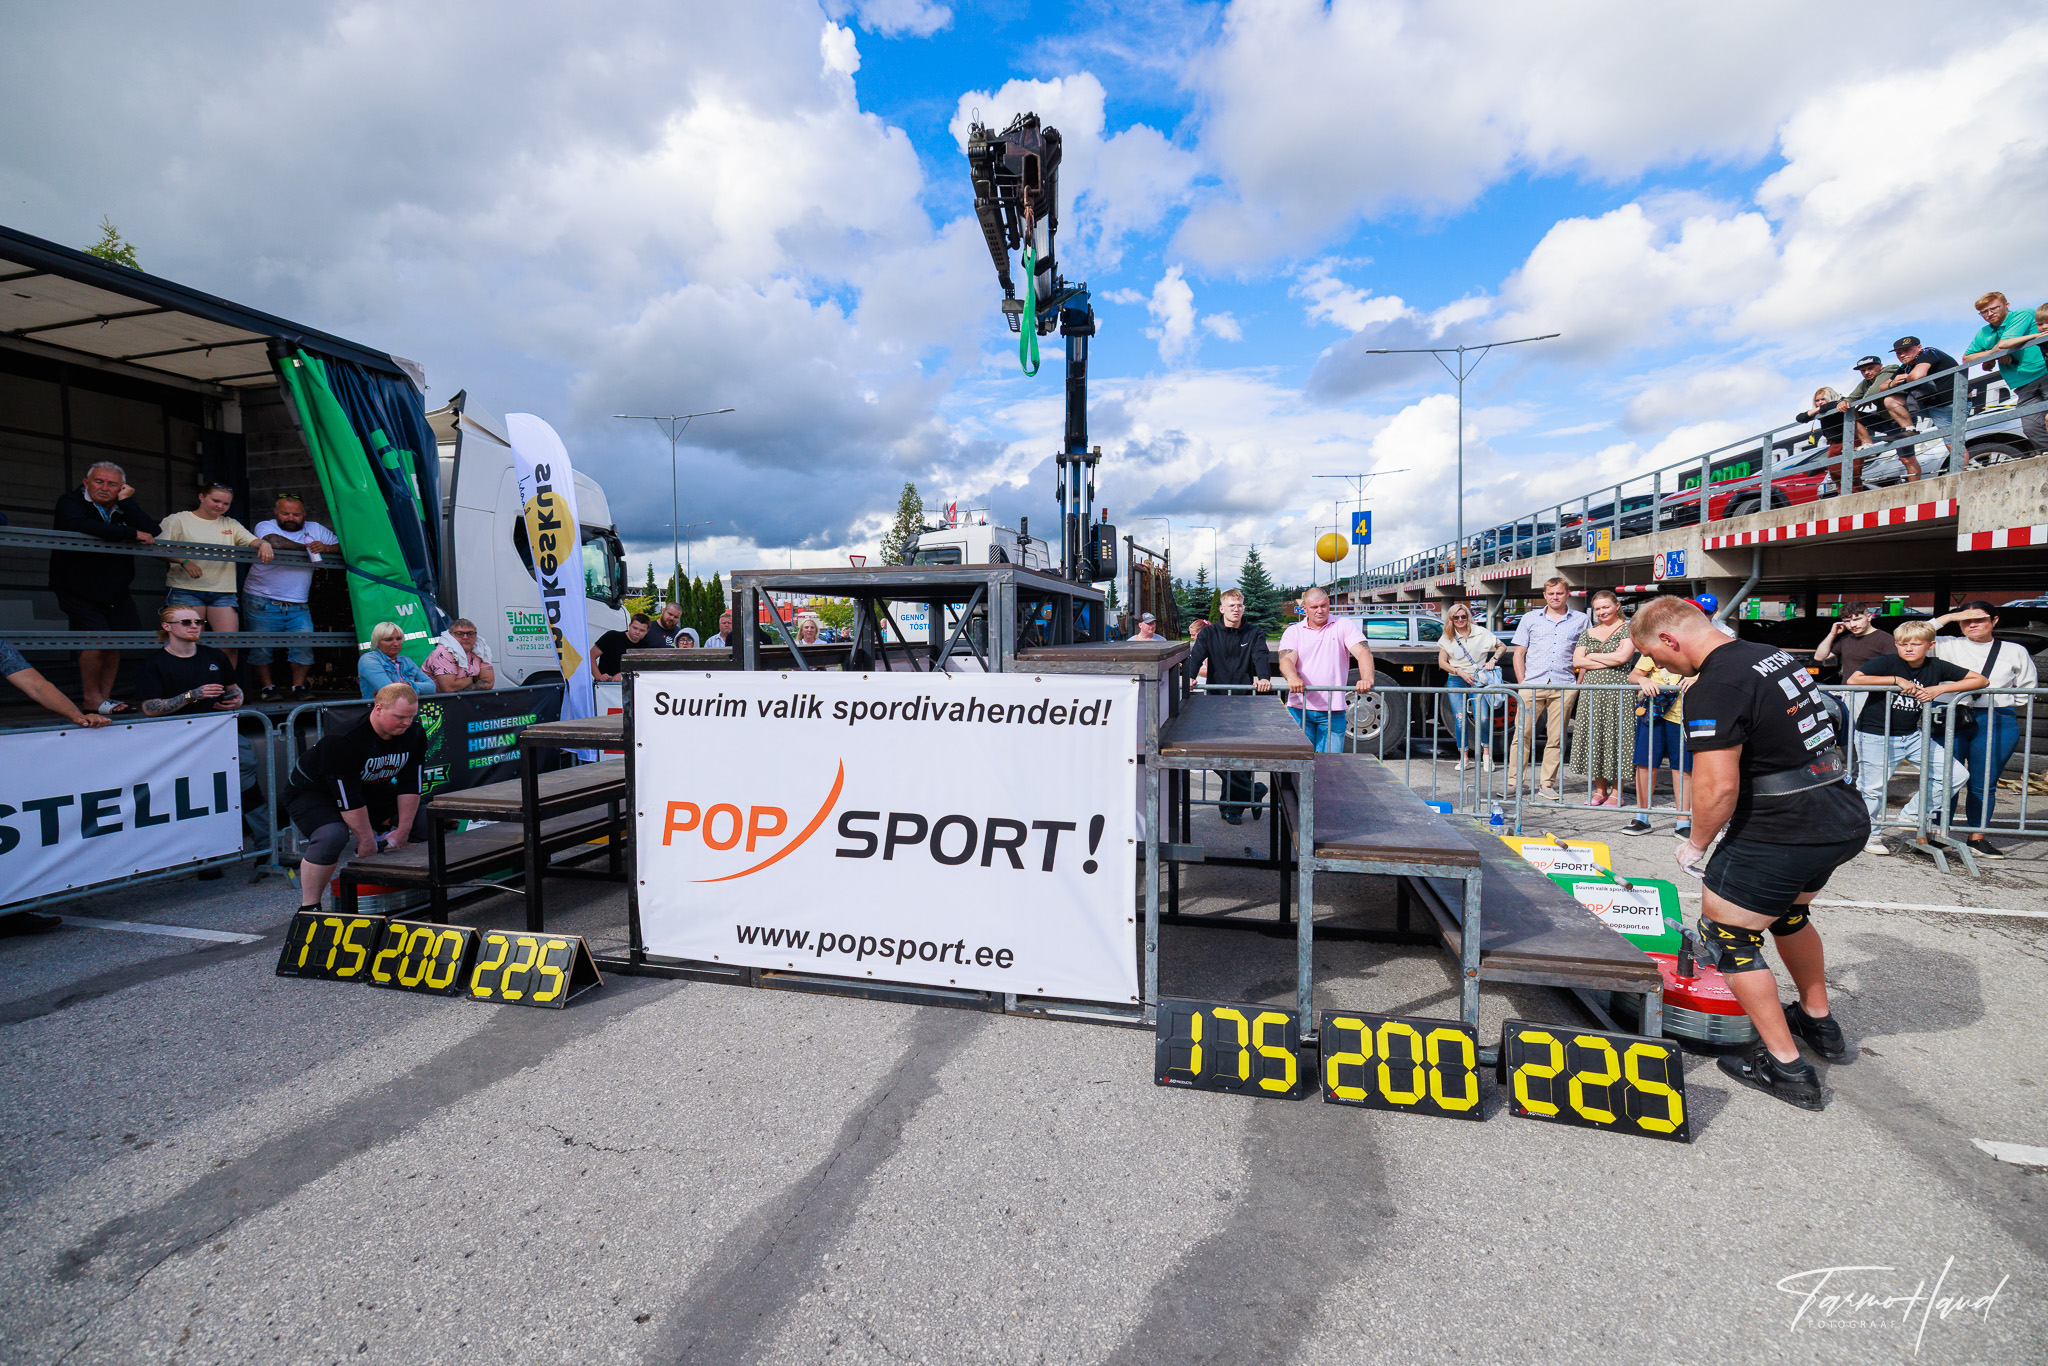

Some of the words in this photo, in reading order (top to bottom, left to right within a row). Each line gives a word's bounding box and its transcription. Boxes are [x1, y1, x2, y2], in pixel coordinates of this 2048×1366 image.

[1355, 519, 1368, 536] 4
[900, 613, 925, 621] GENNO
[468, 714, 537, 733] ENGINEERING
[654, 692, 747, 718] Suurim
[757, 695, 824, 719] valik
[833, 696, 1113, 726] spordivahendeid!
[468, 733, 516, 752] HUMAN
[469, 750, 521, 769] PERFORMAN
[662, 801, 788, 852] POP
[835, 810, 1105, 875] SPORT!
[1554, 862, 1594, 872] SPORT!
[1612, 905, 1659, 916] SPORT!
[298, 917, 372, 978] 175
[371, 923, 464, 989] 200
[736, 924, 1015, 970] www.popsport.ee
[470, 934, 569, 1001] 225
[1190, 1007, 1298, 1092] 175
[1326, 1017, 1478, 1112] 200
[1513, 1031, 1683, 1133] 225
